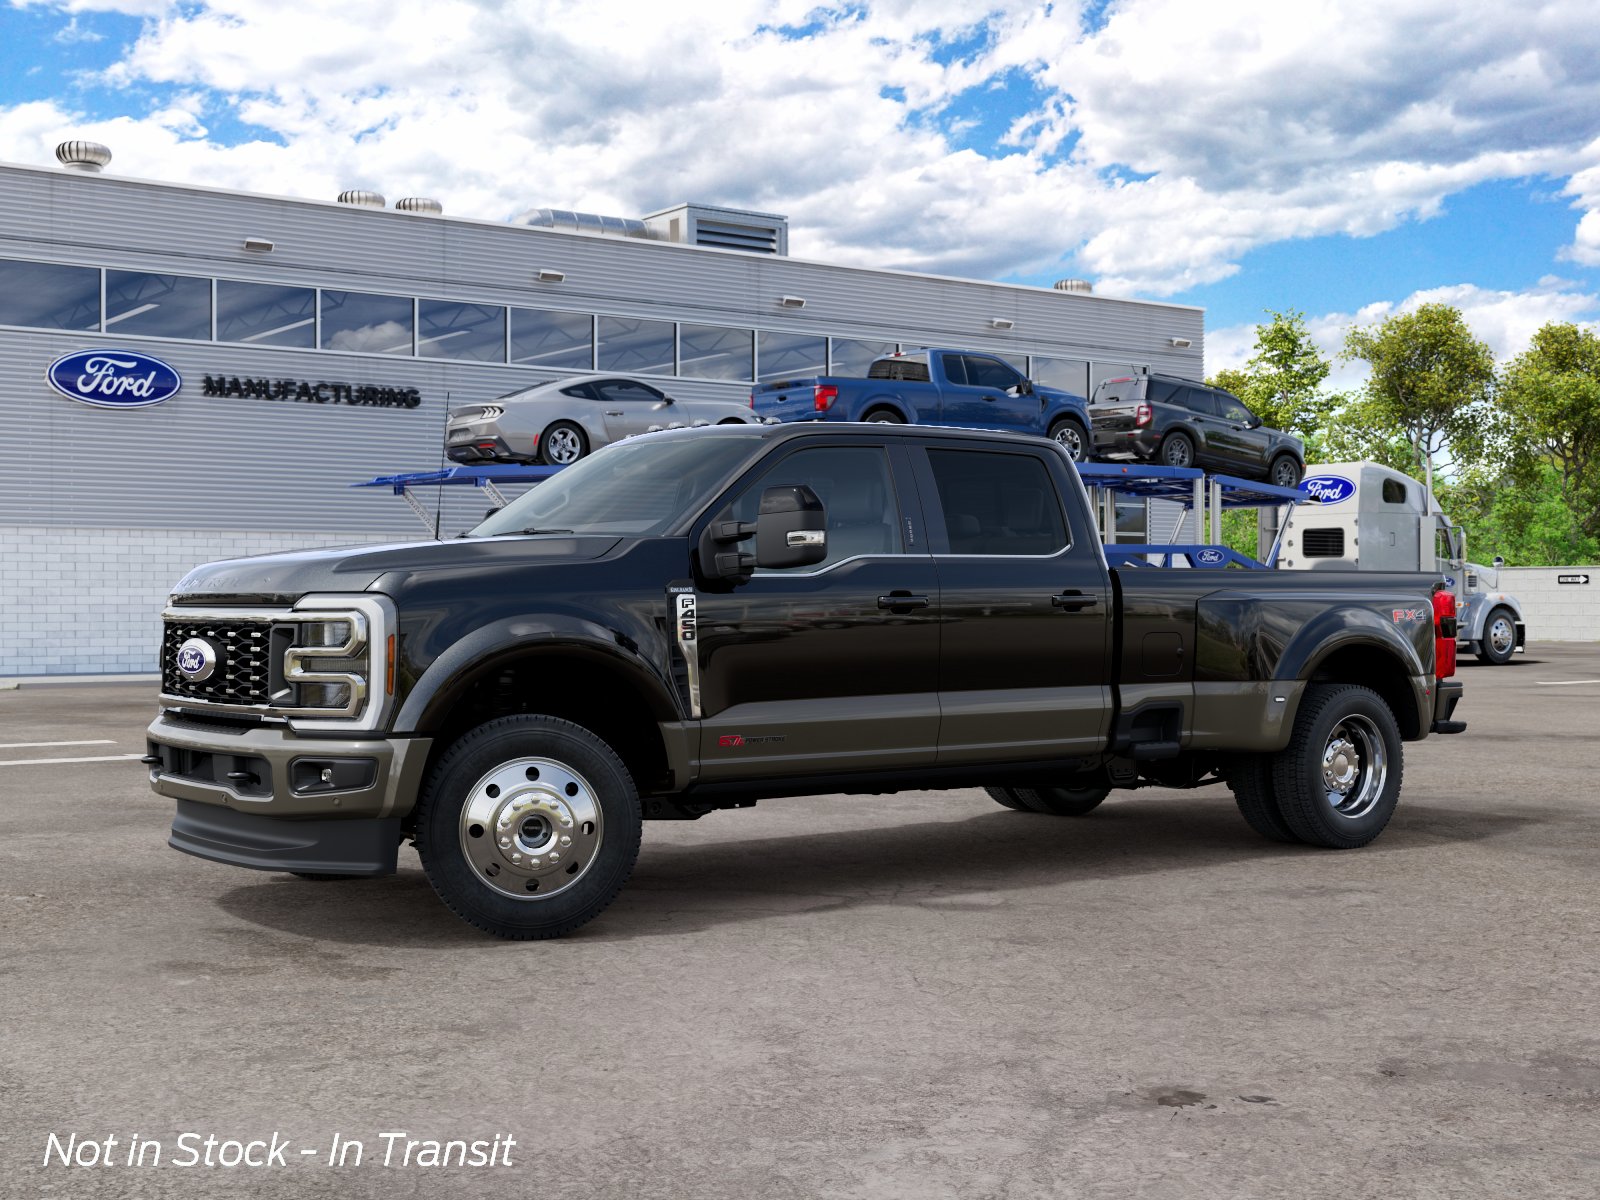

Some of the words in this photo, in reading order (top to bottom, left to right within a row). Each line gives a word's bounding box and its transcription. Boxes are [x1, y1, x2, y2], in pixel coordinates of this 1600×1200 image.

[76, 357, 156, 398] Ford
[203, 373, 421, 409] MANUFACTURING
[1305, 479, 1343, 500] Ford
[1392, 608, 1427, 623] FX4
[182, 649, 200, 669] Ford
